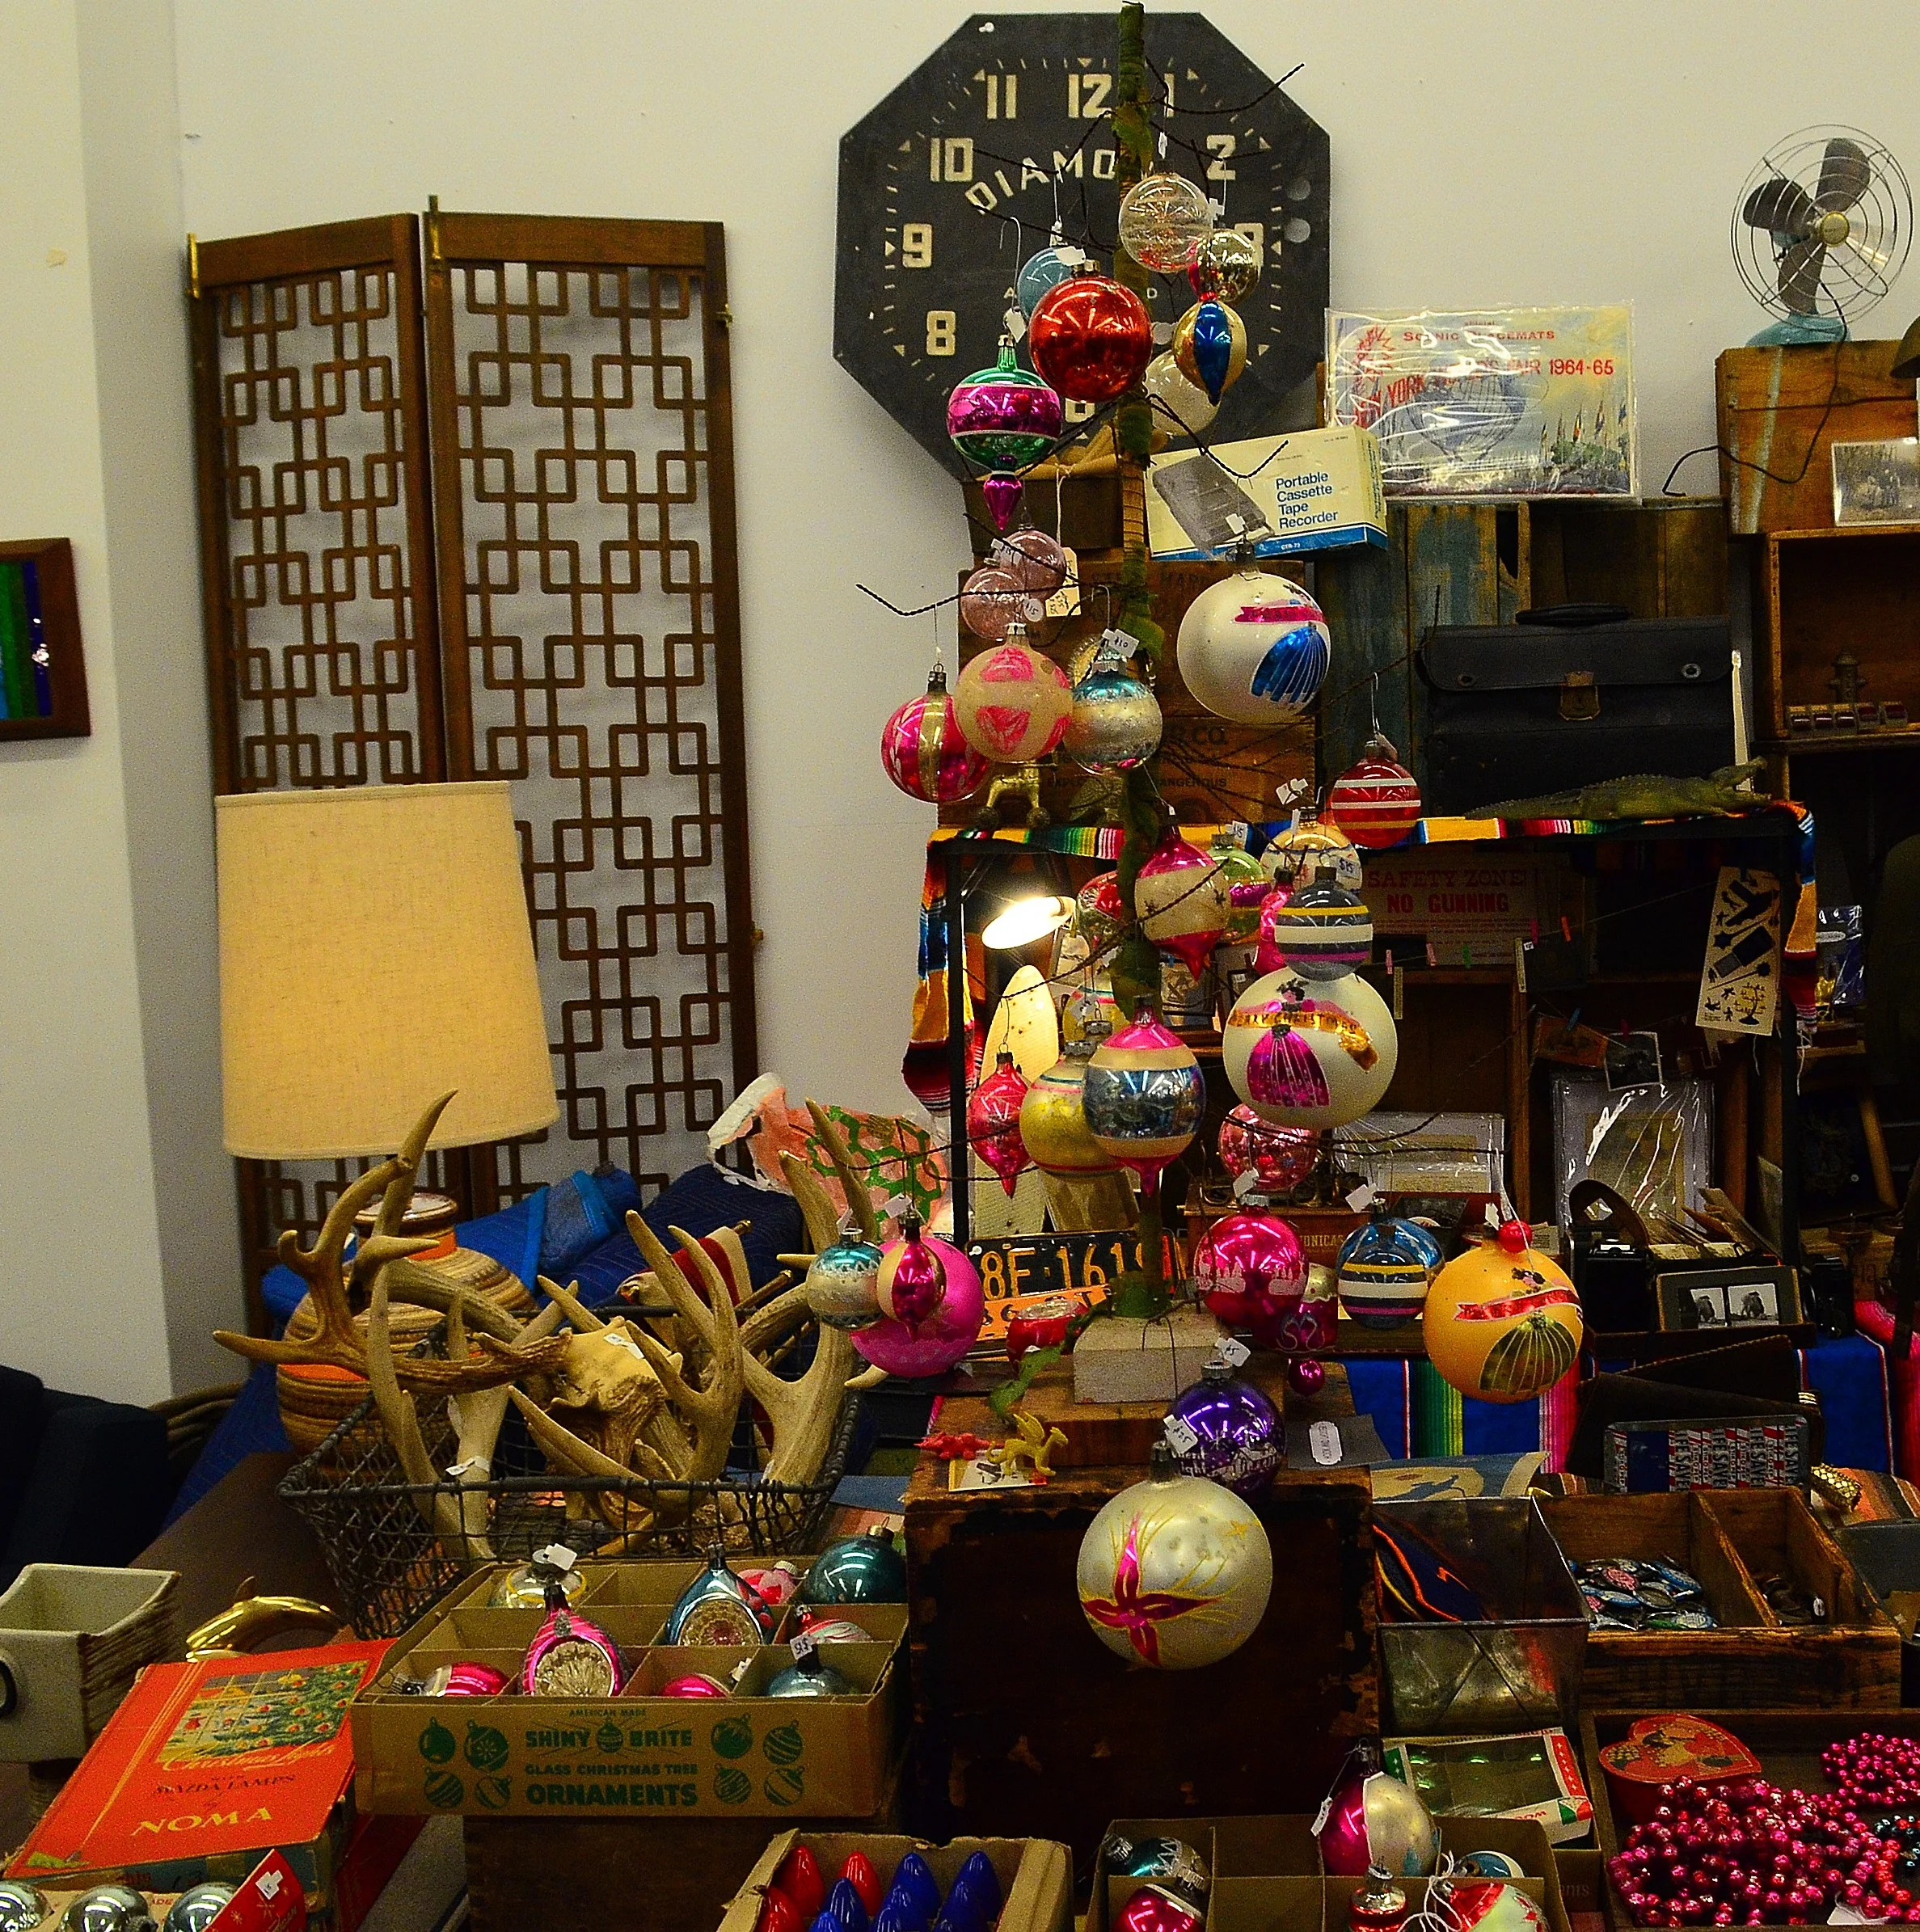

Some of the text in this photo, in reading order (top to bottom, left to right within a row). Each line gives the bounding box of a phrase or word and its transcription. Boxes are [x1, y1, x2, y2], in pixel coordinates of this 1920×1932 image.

[985, 74, 1016, 119] 11
[1068, 73, 1112, 118] 12
[930, 137, 974, 182] 10
[1206, 134, 1237, 180] 2
[965, 148, 1116, 215] DIAMO
[902, 223, 932, 268] 9
[926, 310, 956, 356] 8
[1403, 331, 1460, 342] SCNIC
[1548, 358, 1614, 377] 1964-65
[1276, 471, 1329, 490] Portable
[1276, 483, 1333, 503] Cassette
[1278, 501, 1309, 516] Tape
[1279, 511, 1339, 529] Recorder
[1367, 871, 1458, 888] SAFETY
[1387, 893, 1509, 913] NO GUNNING
[1298, 1234, 1344, 1247] ONICAS
[1675, 1430, 1691, 1452] IFE
[1712, 1428, 1728, 1451] IFE
[1750, 1427, 1766, 1450] IFE
[1785, 1424, 1799, 1449] IFE
[569, 1709, 647, 1717] AMERICAN MADE
[525, 1730, 693, 1748] SHINY BRITE
[525, 1763, 698, 1775] GLASS CHRISTMAS TREE
[526, 1783, 698, 1807] ORNAMENTS
[130, 1806, 273, 1837] NOMA
